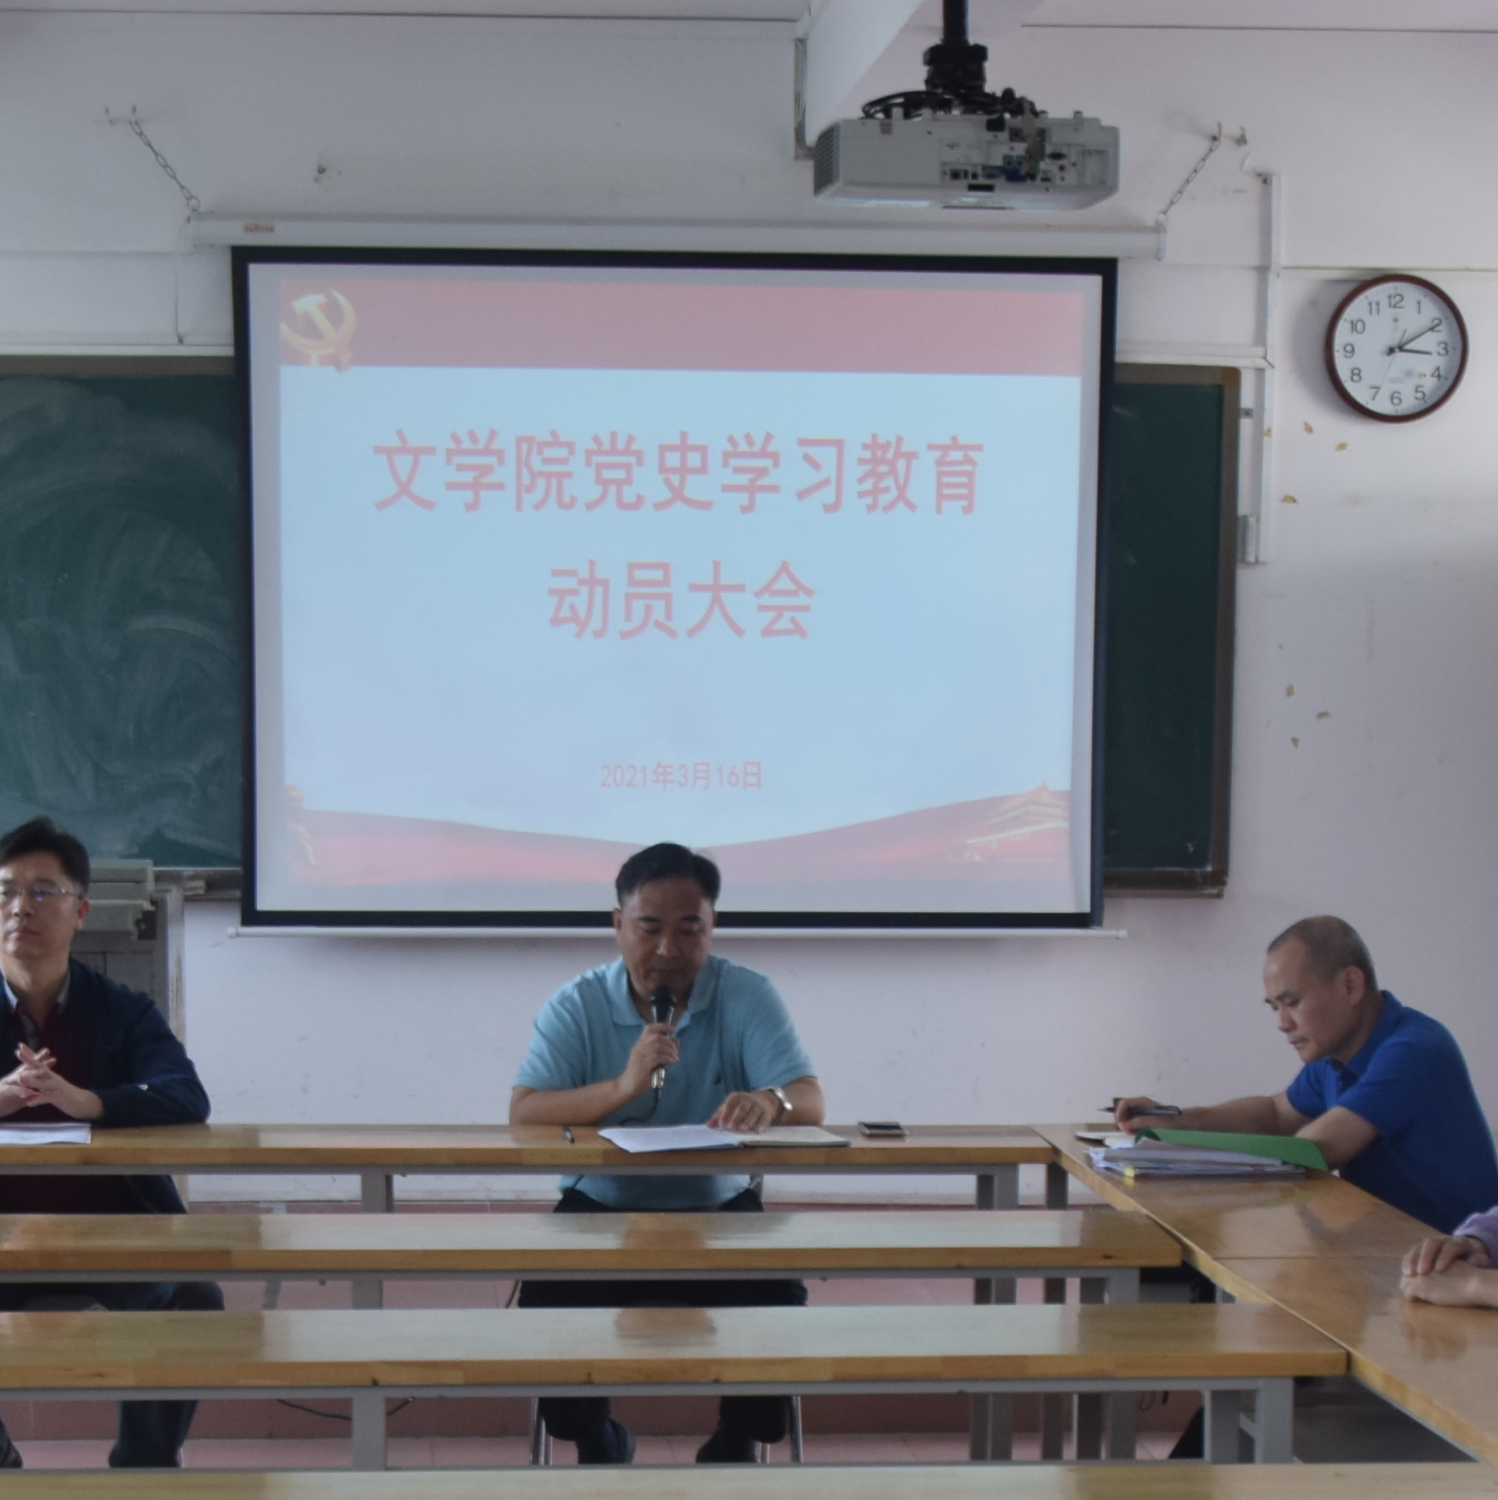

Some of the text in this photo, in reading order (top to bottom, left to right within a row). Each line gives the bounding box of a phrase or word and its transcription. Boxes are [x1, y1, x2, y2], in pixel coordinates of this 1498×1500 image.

[1368, 301, 1380, 316] 11
[1387, 293, 1404, 309] 12
[1416, 300, 1422, 315] 1
[1349, 319, 1366, 335] 10
[1430, 317, 1443, 333] 2
[1343, 343, 1355, 359] 9
[1436, 341, 1449, 357] 3
[1350, 367, 1362, 383] 8
[1430, 366, 1442, 381] 4
[1369, 386, 1381, 401] 7
[1389, 391, 1403, 407] 6
[1414, 385, 1426, 401] 5
[372, 428, 985, 516] 文学院党史学习教育
[547, 559, 816, 642] 动员大会
[600, 760, 763, 792] 2021年3月16日
